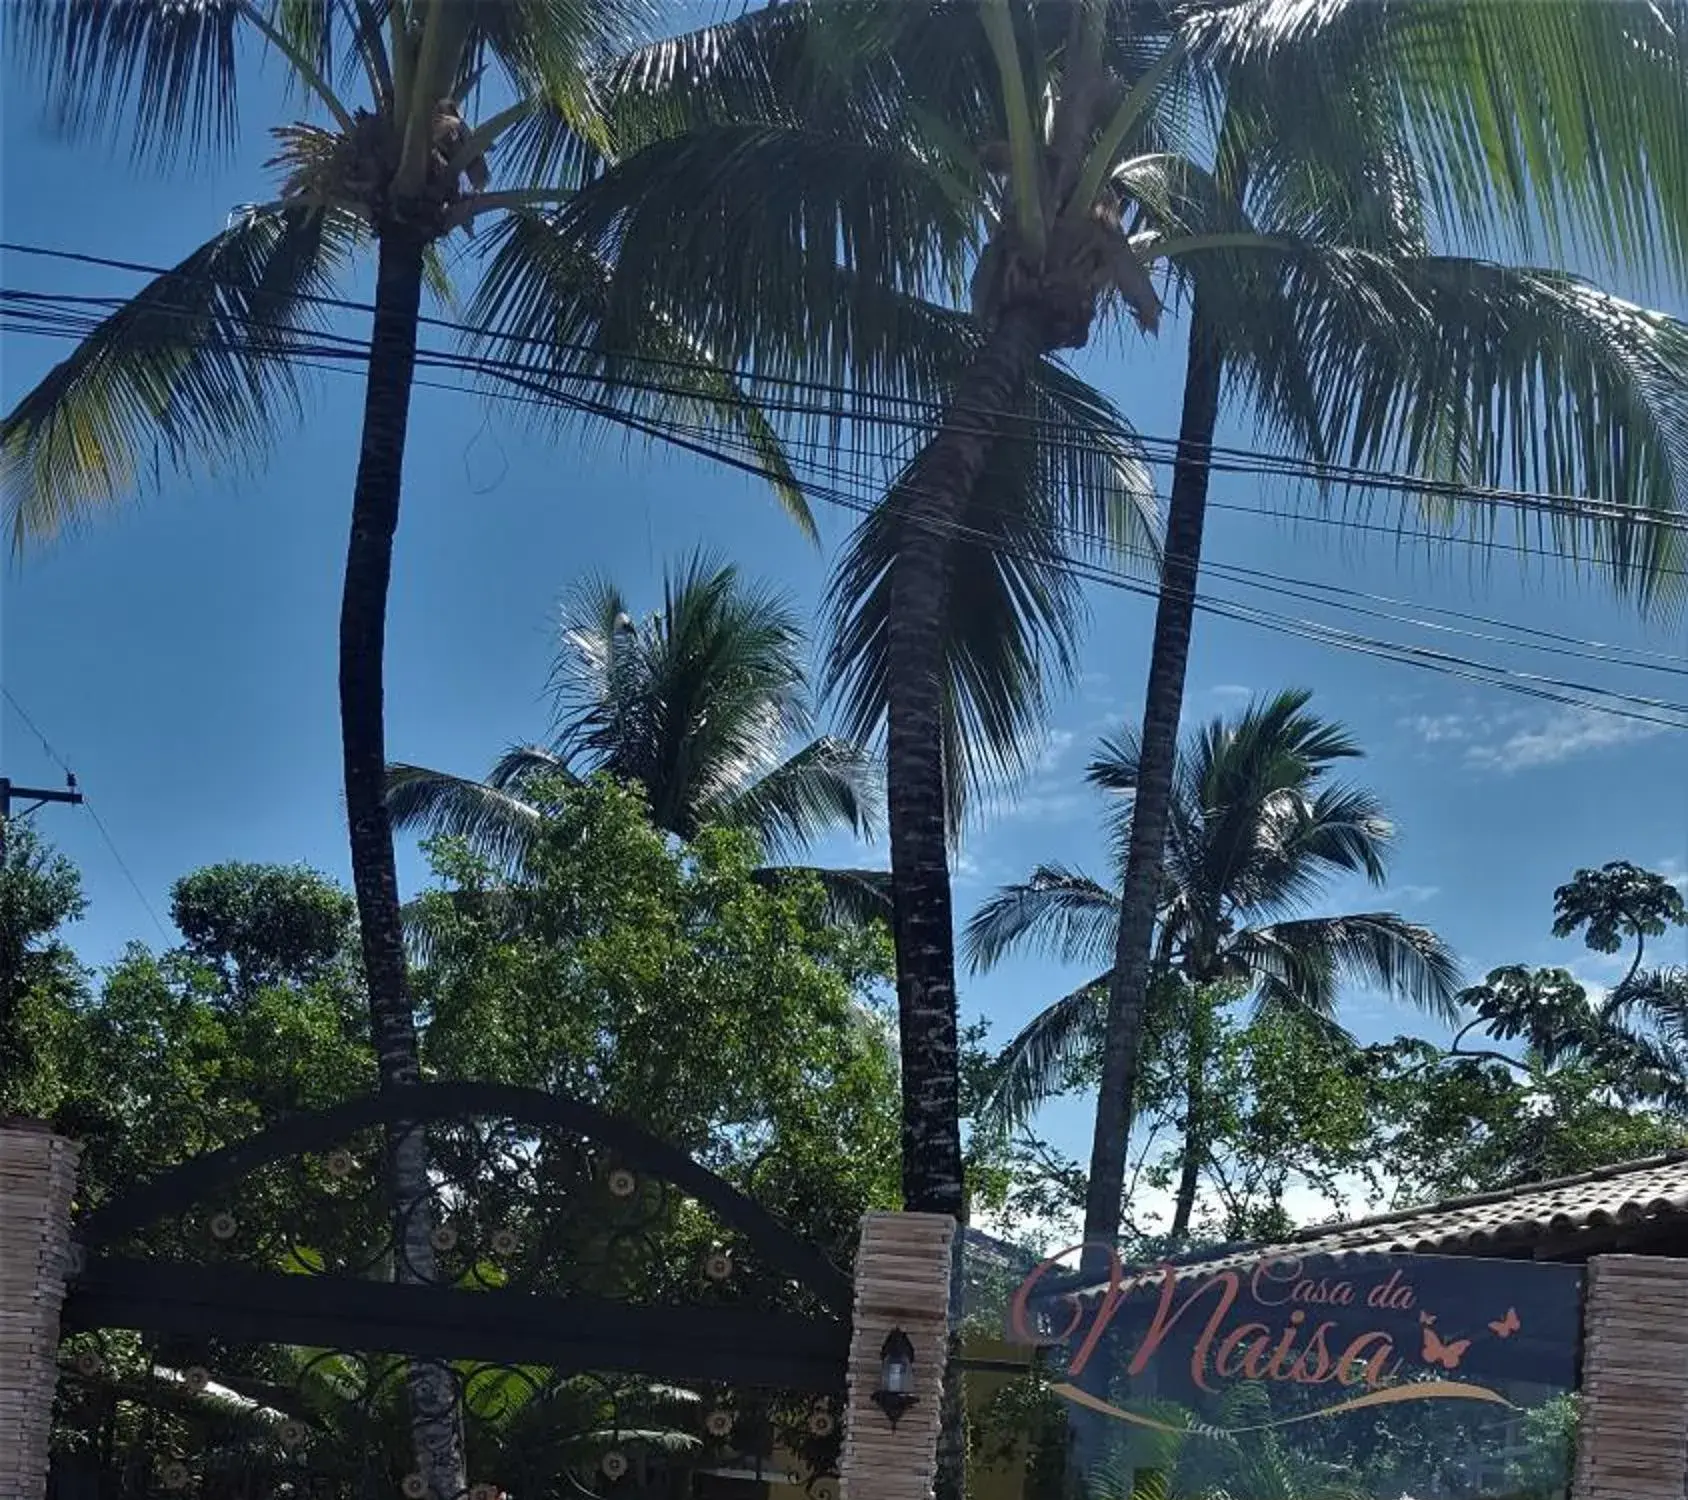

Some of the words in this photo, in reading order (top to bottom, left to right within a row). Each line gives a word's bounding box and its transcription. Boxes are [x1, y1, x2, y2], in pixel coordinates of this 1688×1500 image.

[1011, 1241, 1404, 1394] Maisa
[1251, 1255, 1355, 1306] Casa
[1367, 1269, 1416, 1309] da
